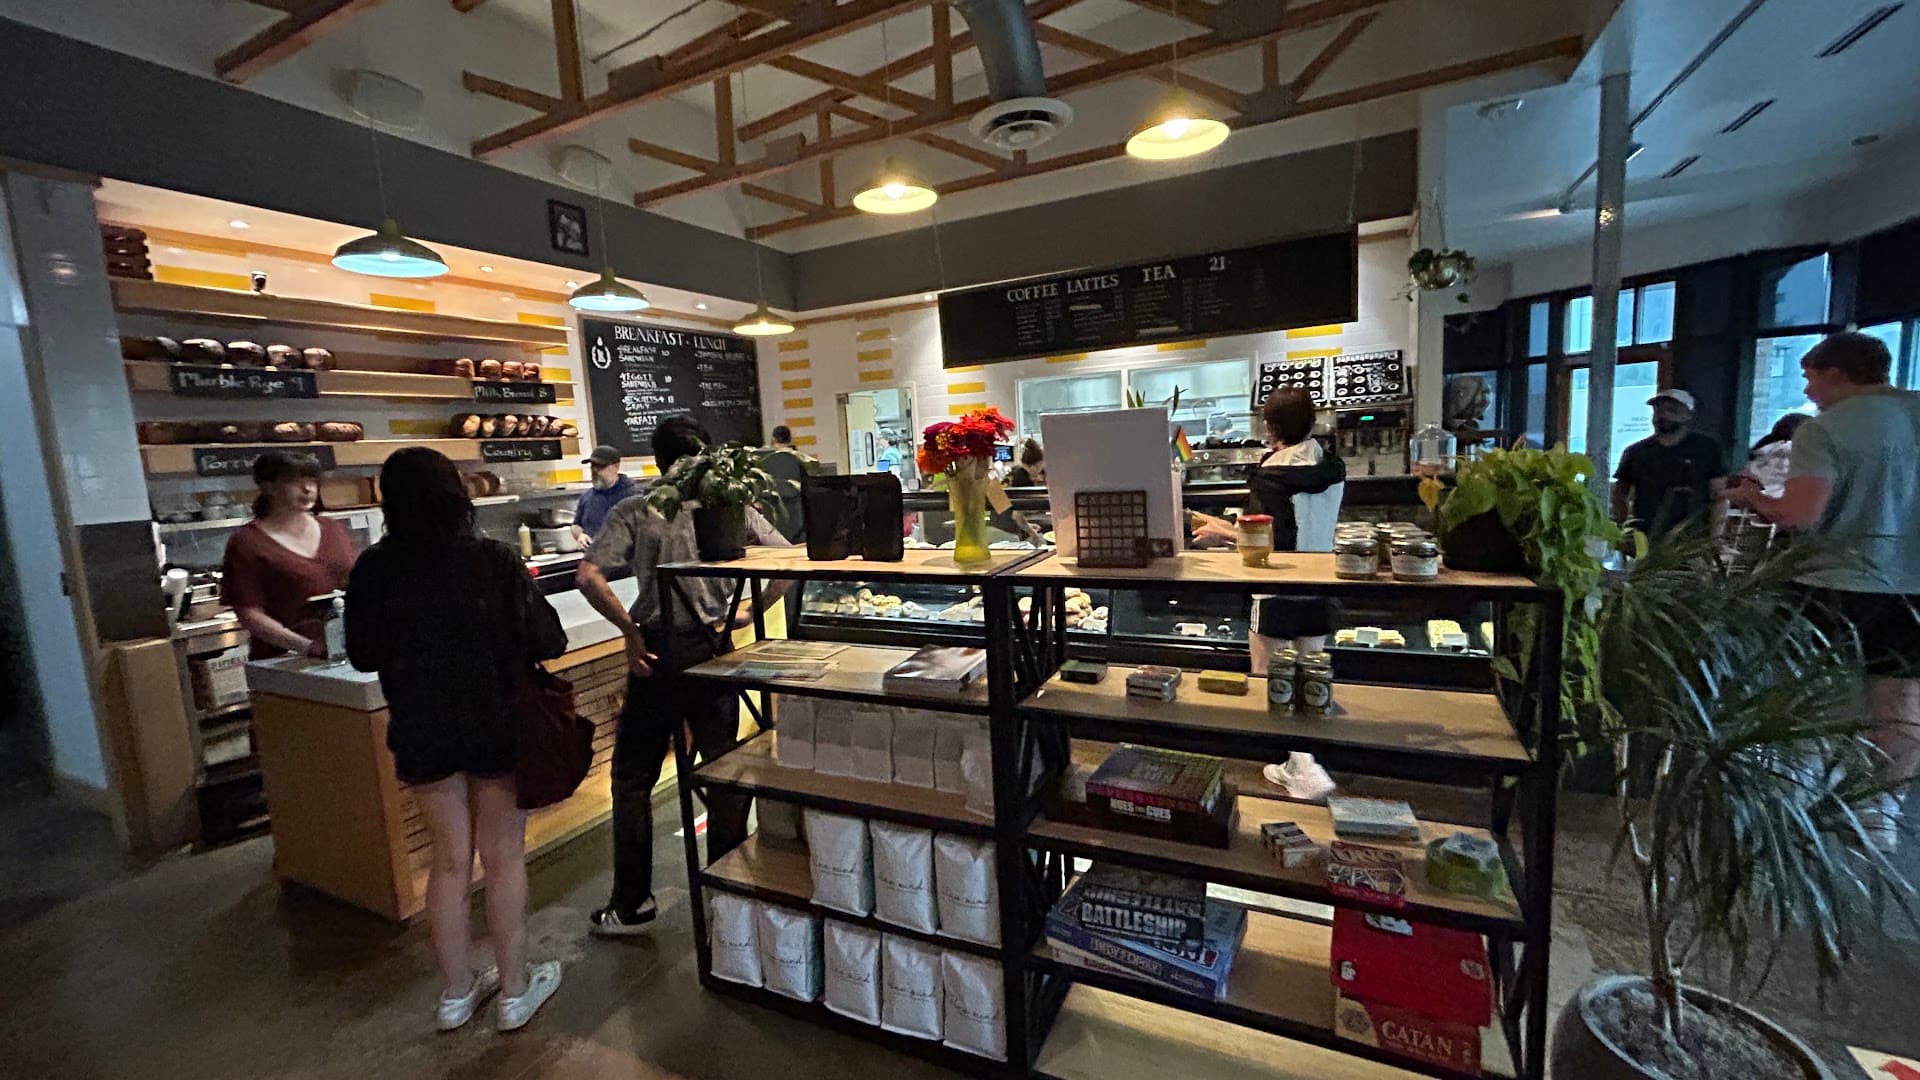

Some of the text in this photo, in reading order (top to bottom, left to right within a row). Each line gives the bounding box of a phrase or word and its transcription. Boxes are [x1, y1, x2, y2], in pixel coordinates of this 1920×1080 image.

[1007, 282, 1059, 303] COFFEE
[1066, 273, 1119, 295] LATTES
[1142, 264, 1177, 283] TEA
[614, 326, 727, 350] BREAKFAST LUNCH
[178, 372, 246, 389] Marble
[248, 375, 287, 394] Rye
[483, 443, 533, 458] Country
[1080, 901, 1188, 939] BATTLESHIP
[1382, 1020, 1453, 1056] CATAN
